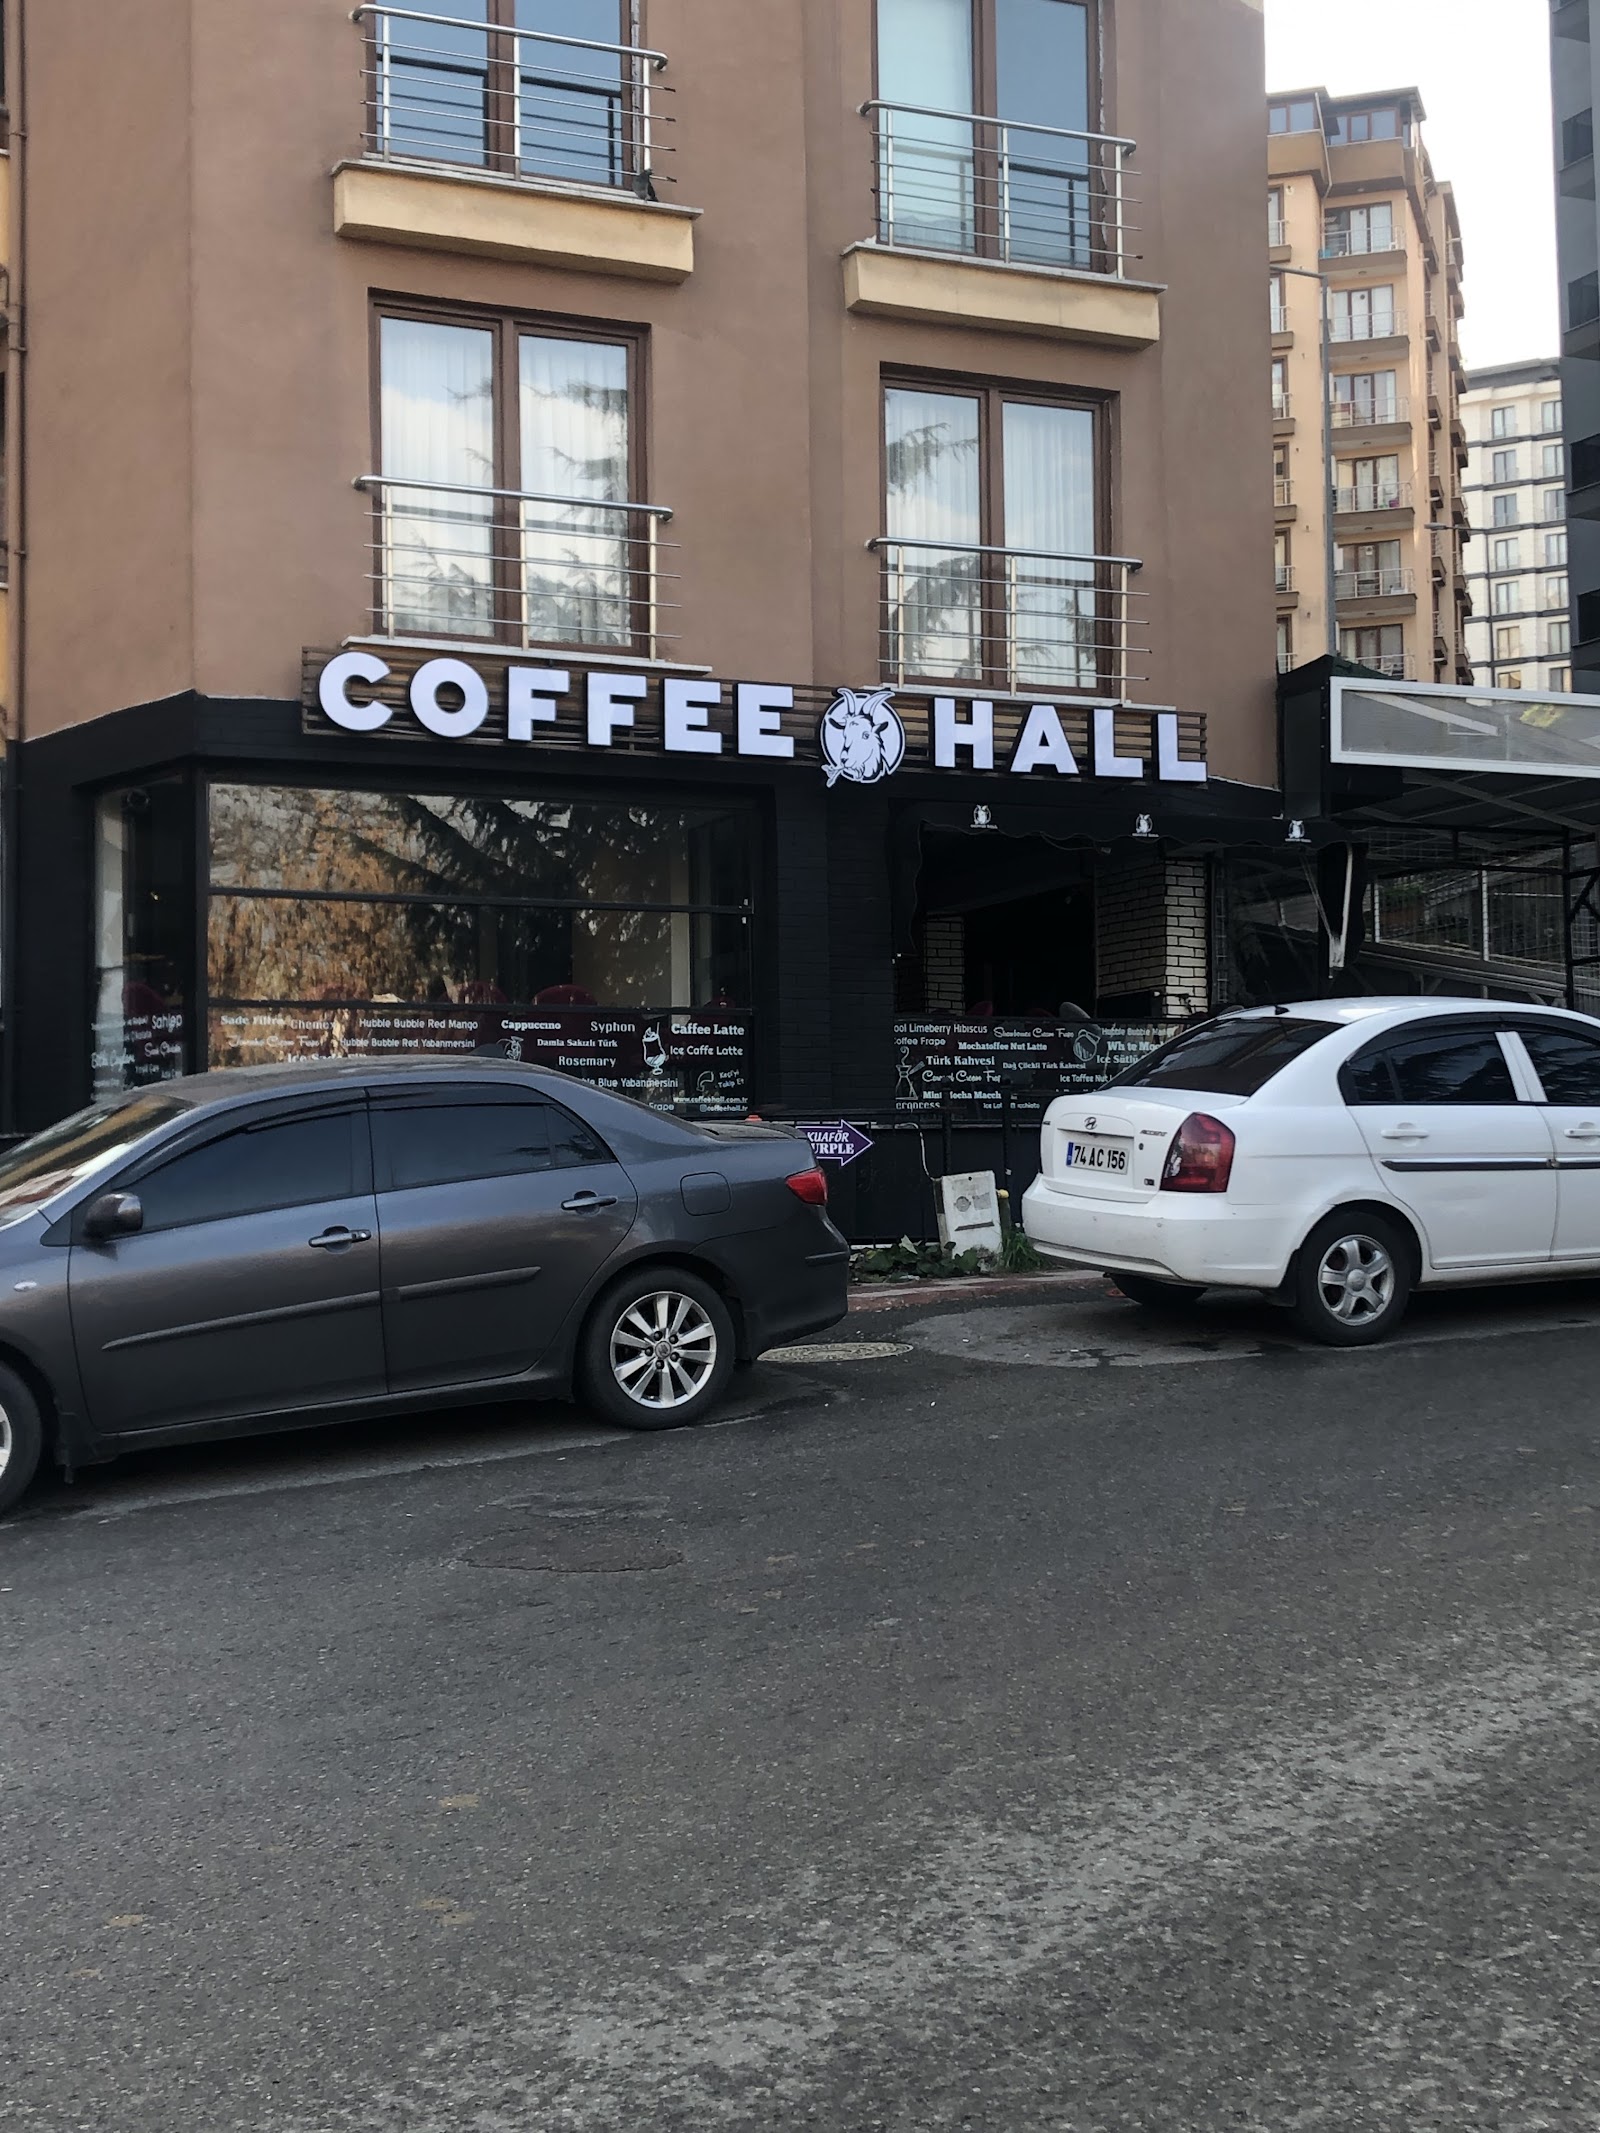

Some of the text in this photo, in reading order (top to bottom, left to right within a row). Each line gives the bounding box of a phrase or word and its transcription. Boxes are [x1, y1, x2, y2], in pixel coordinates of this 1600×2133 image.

[318, 651, 1207, 782] COFFEE HALL
[220, 1015, 250, 1025] Sade
[359, 1018, 479, 1031] Hubble Bubble Red Mango
[590, 1021, 636, 1034] Syphon
[671, 1023, 745, 1036] Caffee Latte
[893, 1024, 907, 1033] ool
[909, 1024, 952, 1035] Limeberry
[340, 1038, 476, 1049] Hubble Bubble Red Yabanmersini
[537, 1039, 564, 1047] Damla
[598, 1039, 619, 1048] Türk
[920, 1037, 947, 1047] Frape
[957, 1041, 1048, 1051] Mochatoffee Nut Latte
[1107, 1041, 1138, 1052] Whte
[670, 1045, 744, 1056] Ice Caffe Latte
[558, 1056, 617, 1068] Rosemary
[926, 1055, 996, 1066] Türk Kahvesi
[1096, 1055, 1112, 1064] Ice
[597, 1078, 619, 1088] Blue
[619, 1077, 679, 1089] Yabanmersini
[1071, 1074, 1094, 1082] Toffee
[807, 1129, 850, 1143] KUAFÖR
[811, 1142, 855, 1155] URPLE
[1073, 1145, 1126, 1170] 74 AC 156
